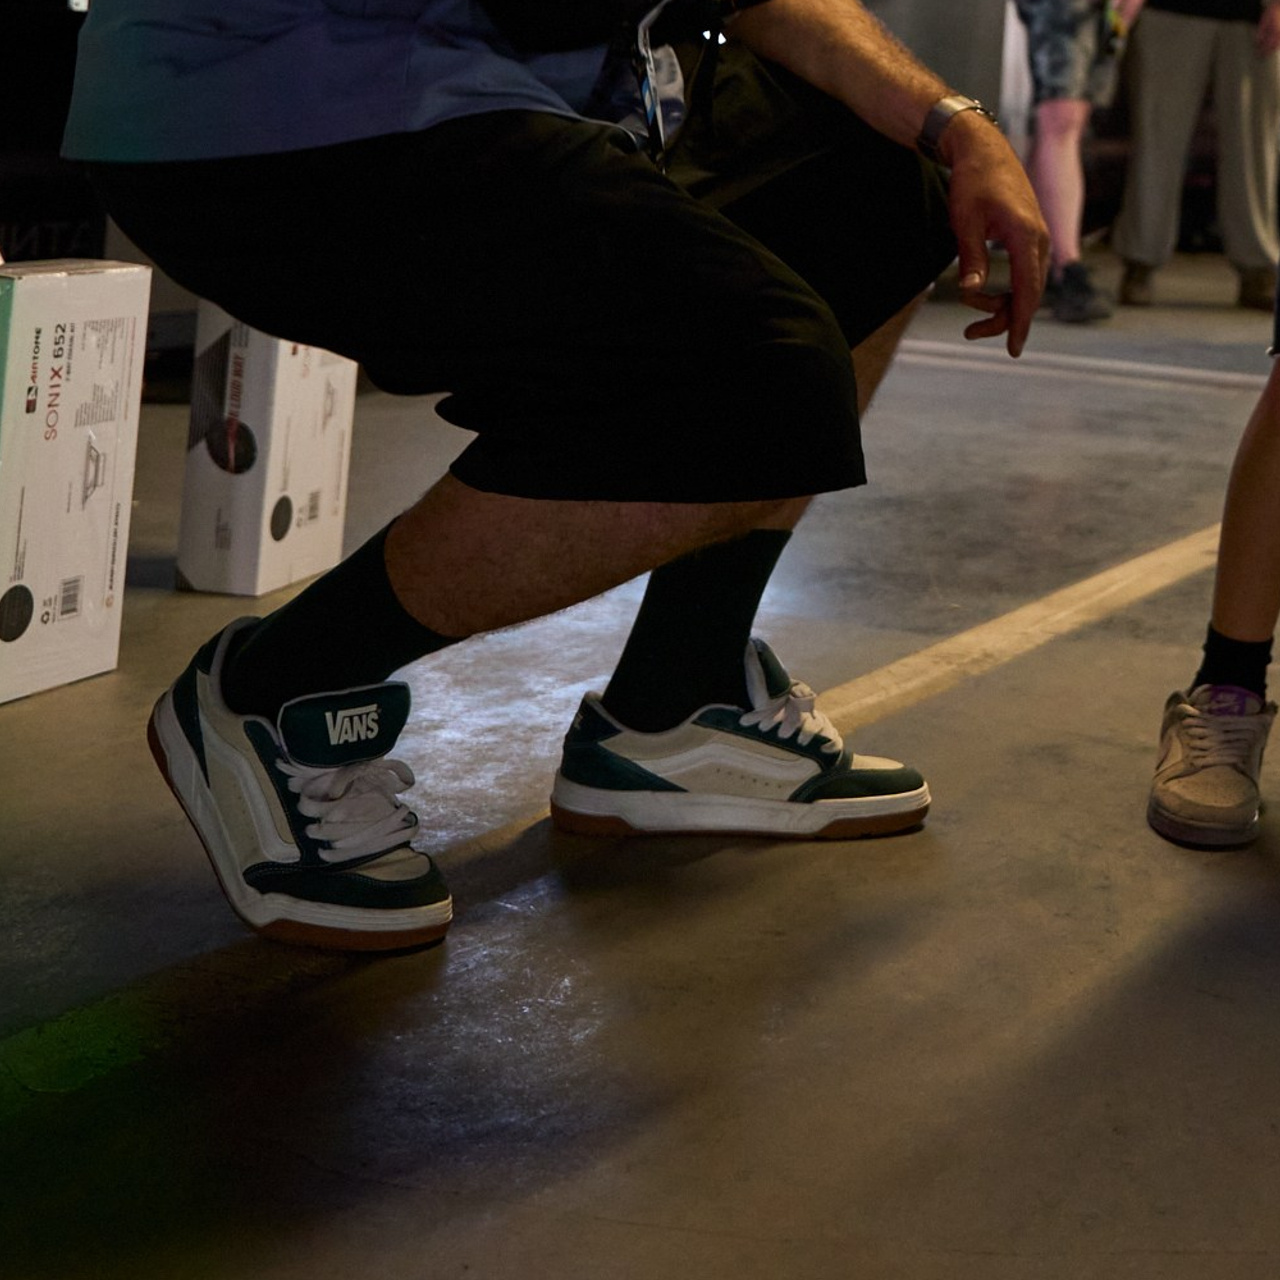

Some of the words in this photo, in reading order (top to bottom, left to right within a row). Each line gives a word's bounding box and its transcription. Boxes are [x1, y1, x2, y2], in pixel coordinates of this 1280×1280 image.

[53, 323, 66, 359] 652
[44, 365, 63, 440] SONIX
[325, 703, 379, 746] VANS
